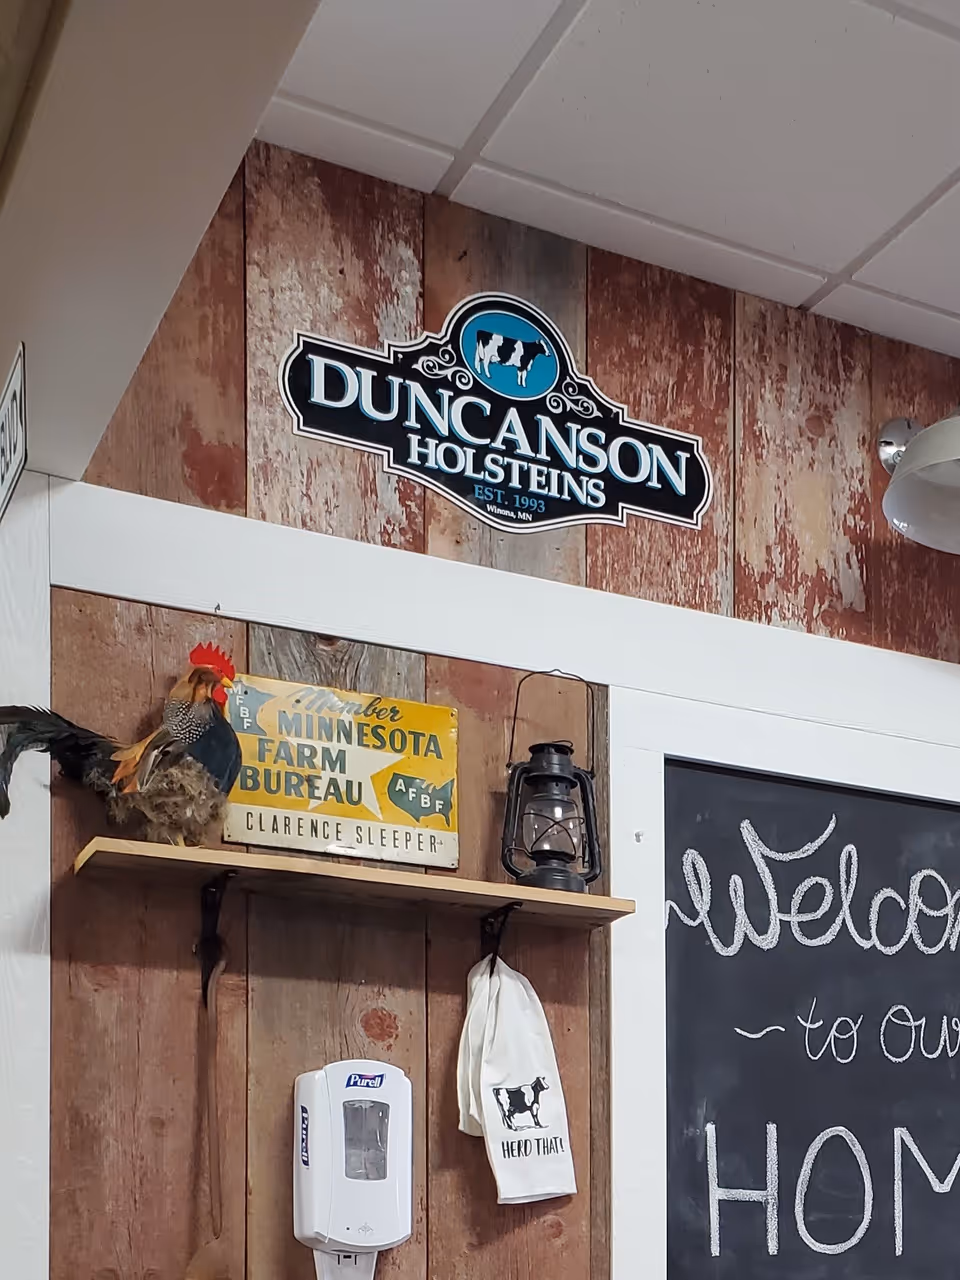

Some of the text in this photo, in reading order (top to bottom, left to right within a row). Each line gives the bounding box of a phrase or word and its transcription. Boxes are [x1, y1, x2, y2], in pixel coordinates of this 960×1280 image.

[307, 353, 691, 497] DUNCANSON
[407, 433, 606, 509] HOLSTEINS
[474, 484, 546, 513] EST. 1993
[486, 503, 533, 522] Winona, MN
[287, 687, 404, 724] Member
[277, 709, 444, 760] MINNESOTA
[257, 737, 347, 775] FARM
[239, 764, 363, 806] BUREAU
[246, 811, 438, 854] CLARENCE SLEEPER
[796, 997, 864, 1064] to
[349, 1074, 383, 1087] Purell
[501, 1137, 565, 1159] HERD THAT!
